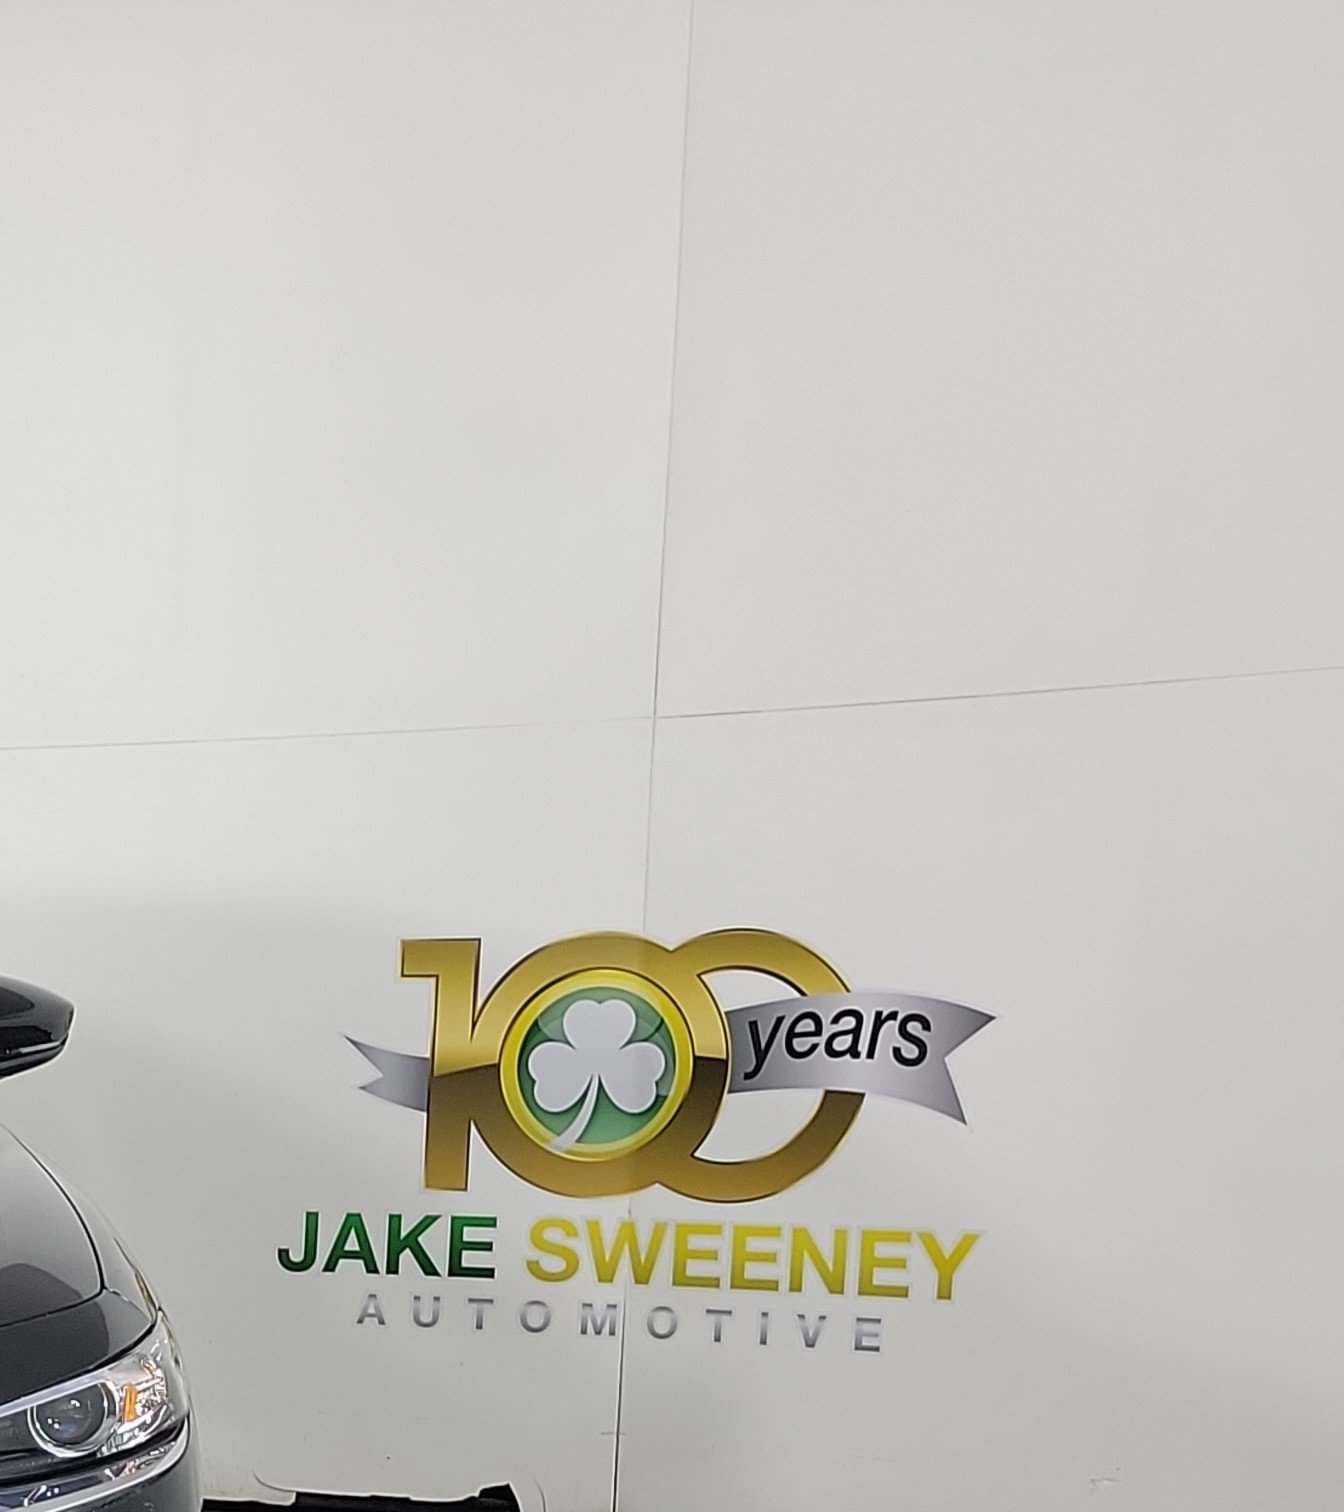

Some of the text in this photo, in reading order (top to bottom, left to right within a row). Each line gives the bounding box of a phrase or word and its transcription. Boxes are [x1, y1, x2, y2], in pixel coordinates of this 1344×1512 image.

[399, 927, 932, 1203] 100 years
[277, 1211, 980, 1301] JAKE SWEENEY
[356, 1293, 884, 1353] AUTOMOTIVE
